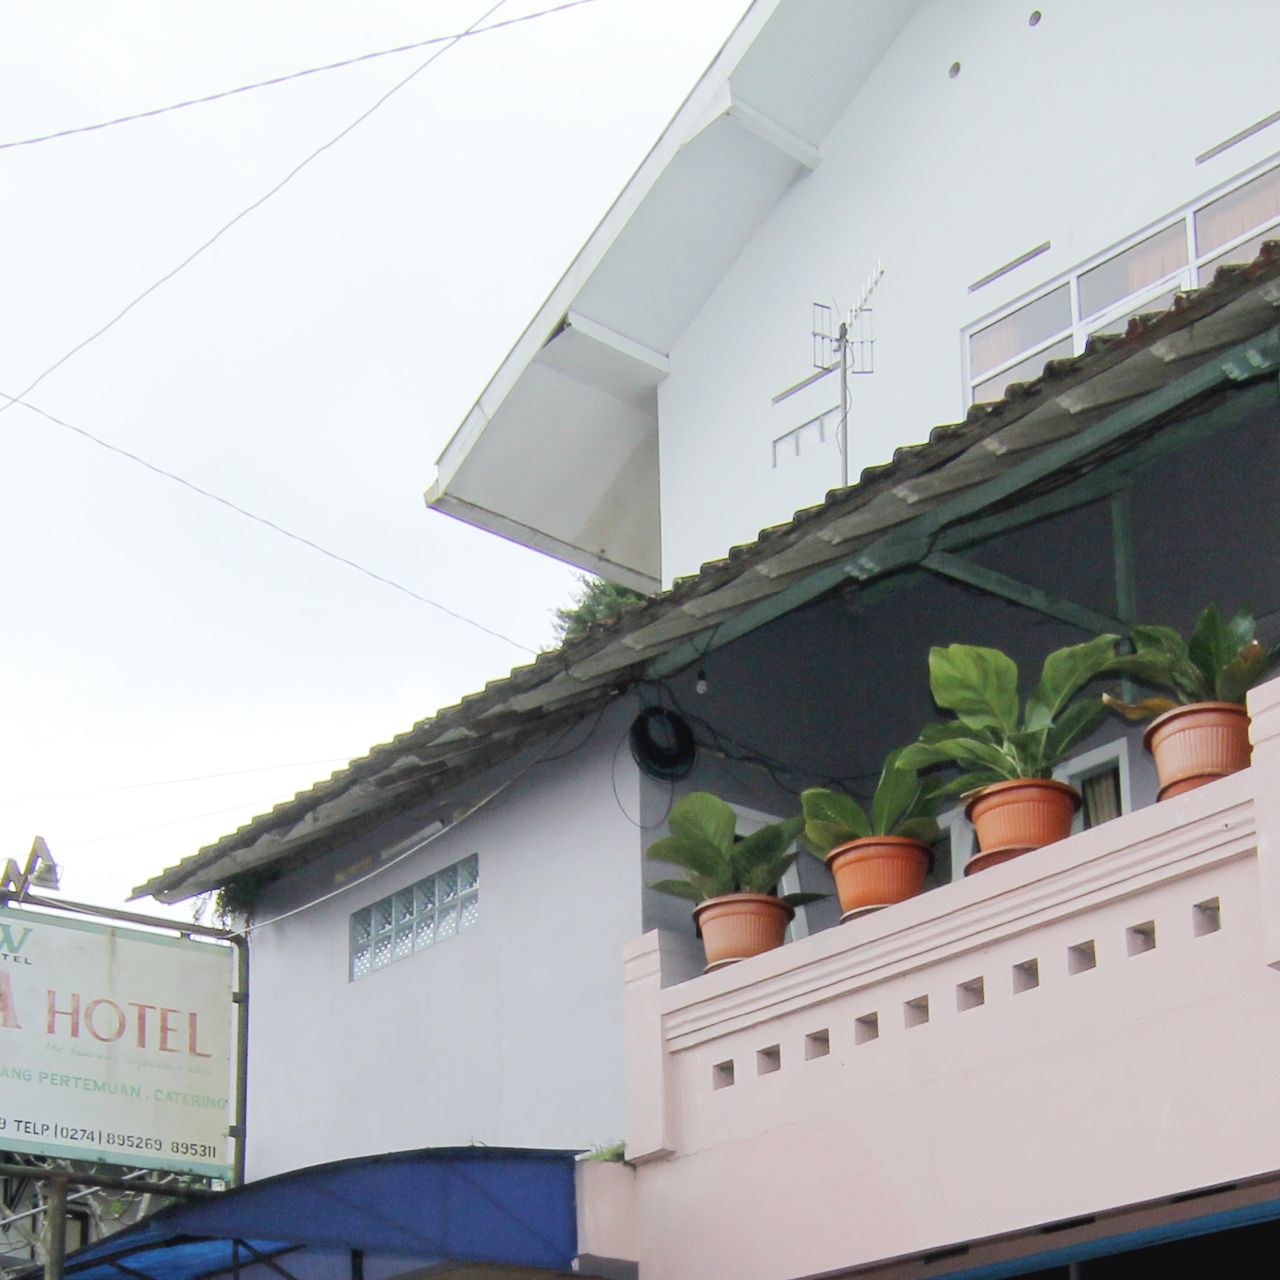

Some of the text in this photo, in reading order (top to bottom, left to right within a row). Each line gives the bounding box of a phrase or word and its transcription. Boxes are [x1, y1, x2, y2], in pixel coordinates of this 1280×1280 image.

[47, 989, 212, 1058] HOTEL
[154, 1089, 227, 1111] CATERING
[107, 1132, 163, 1151] 895269
[170, 1141, 216, 1159] 895311
